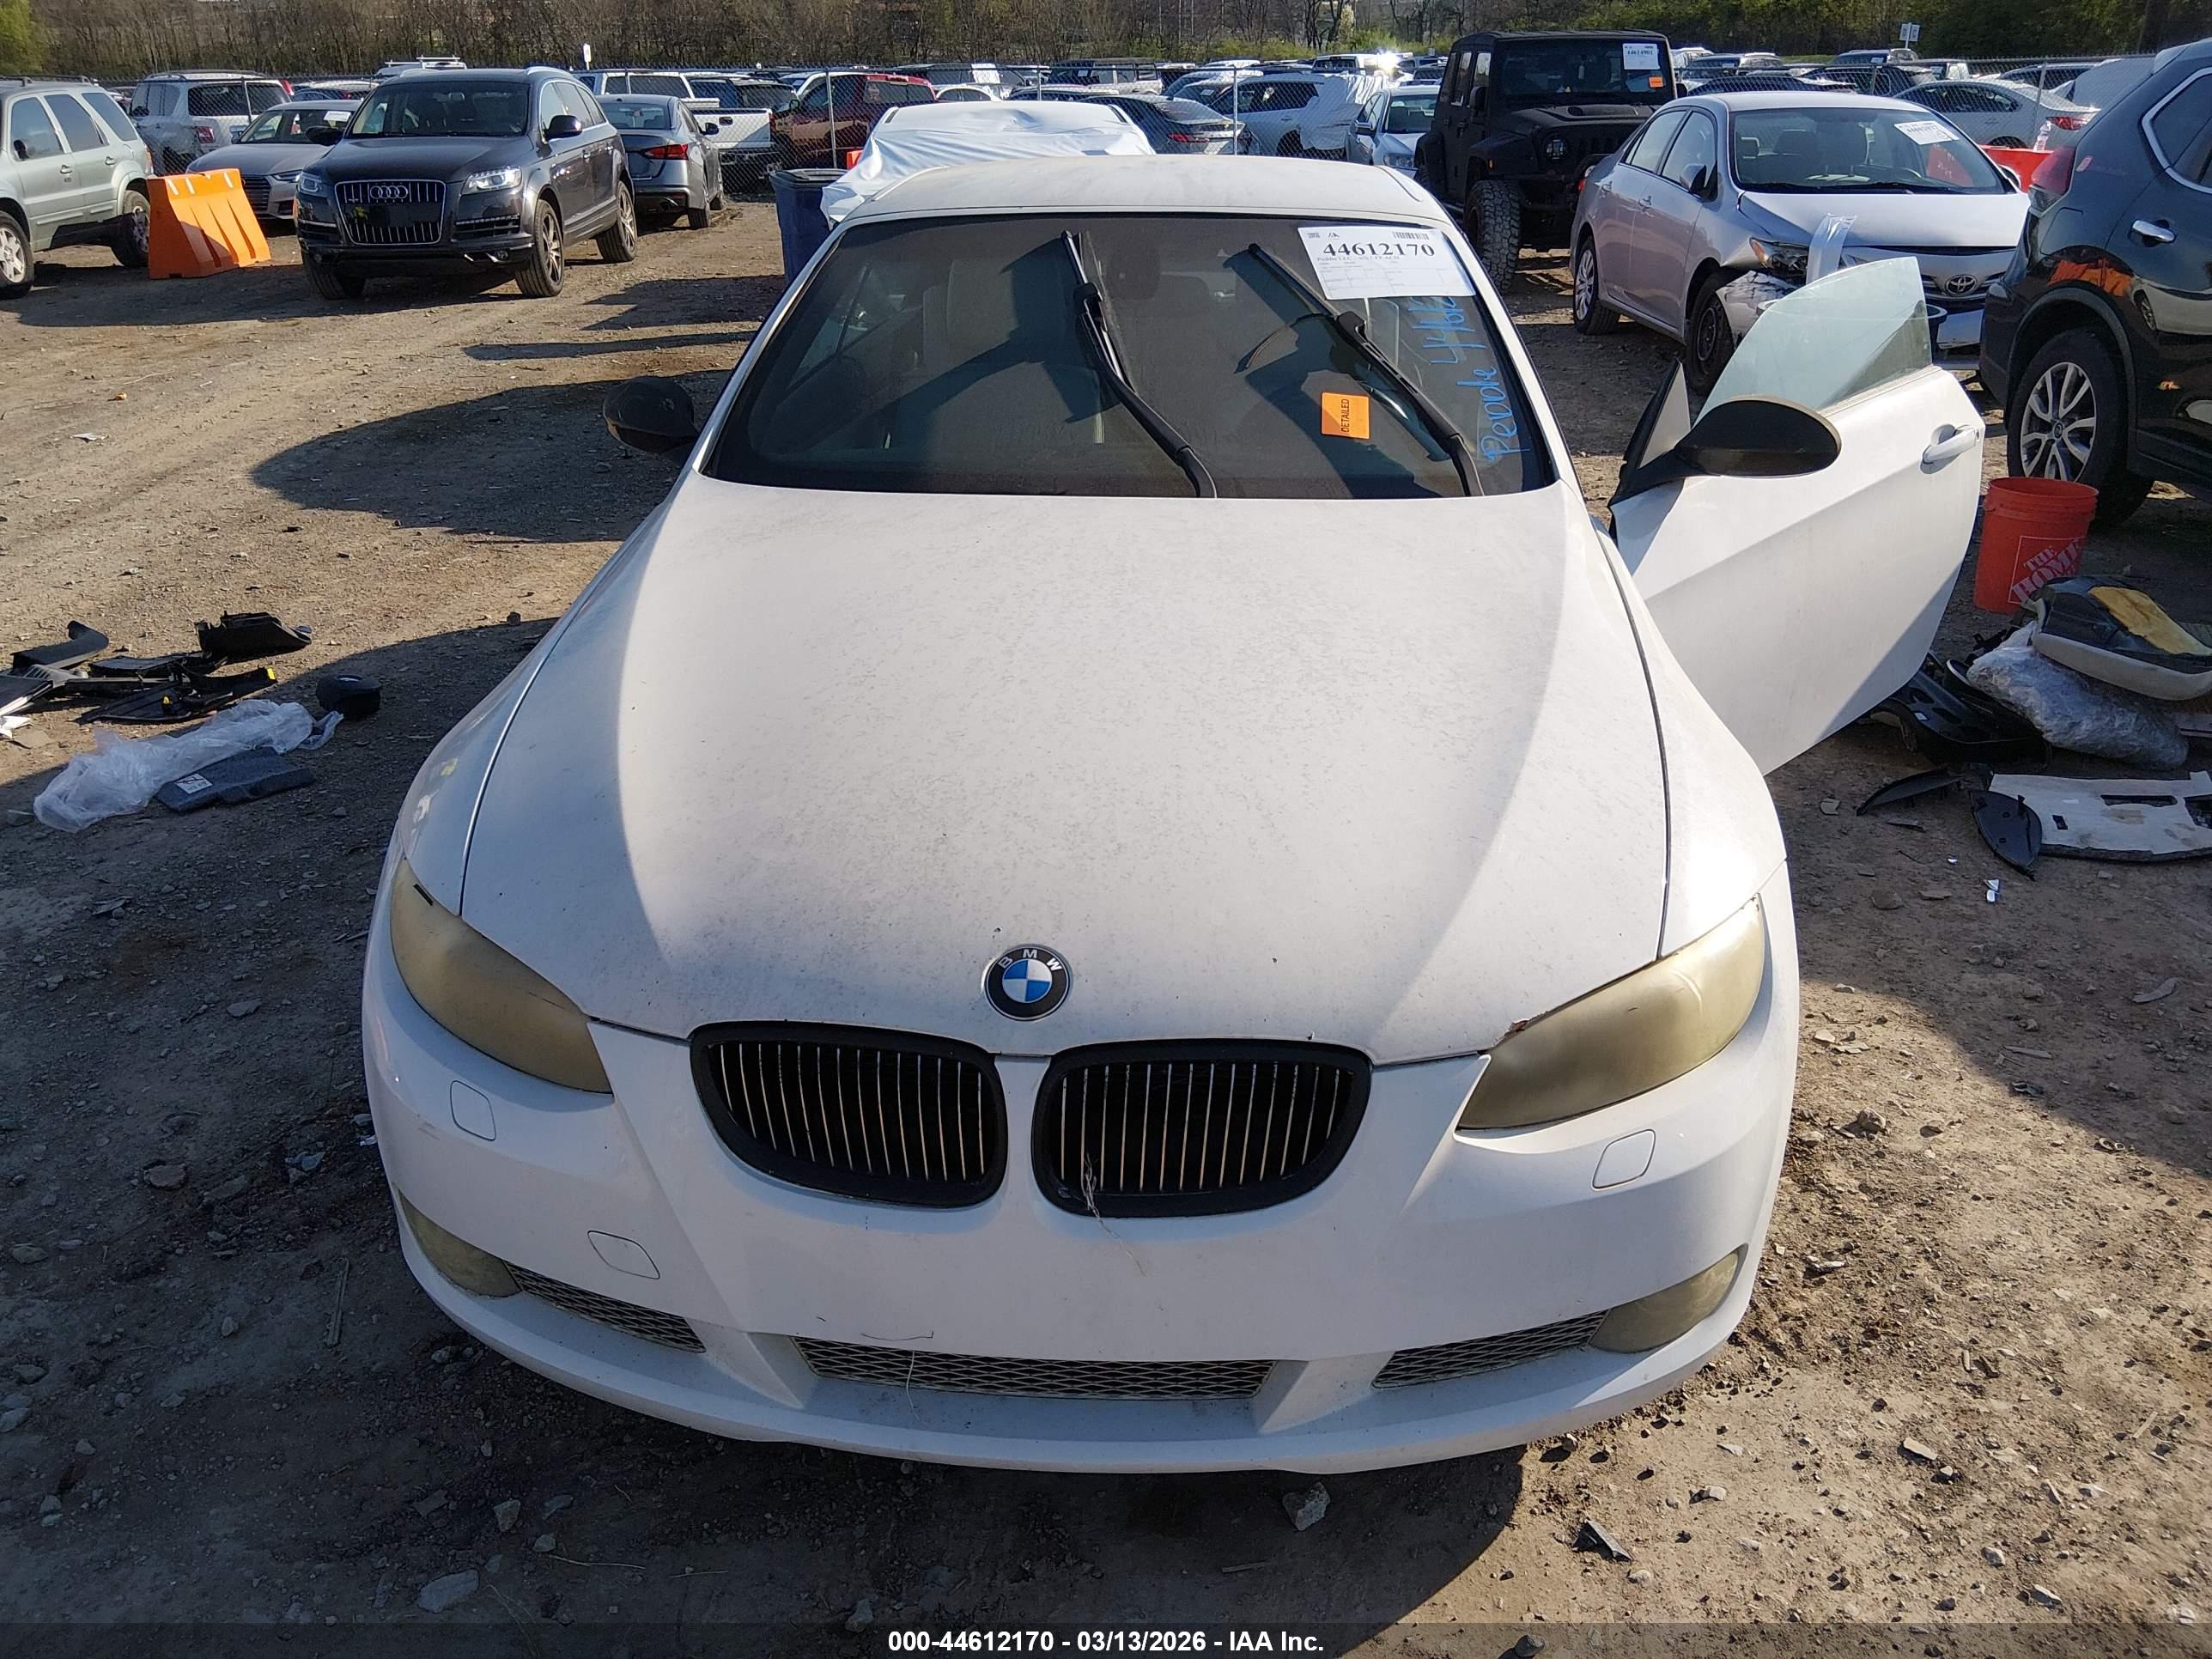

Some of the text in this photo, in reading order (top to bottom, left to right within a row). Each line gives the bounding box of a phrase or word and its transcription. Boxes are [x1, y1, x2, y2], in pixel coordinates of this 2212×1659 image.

[1323, 243, 1435, 256] 44612170
[1340, 398, 1350, 433] DETAILED
[2023, 545, 2057, 573] THE
[997, 949, 1063, 971] BMW
